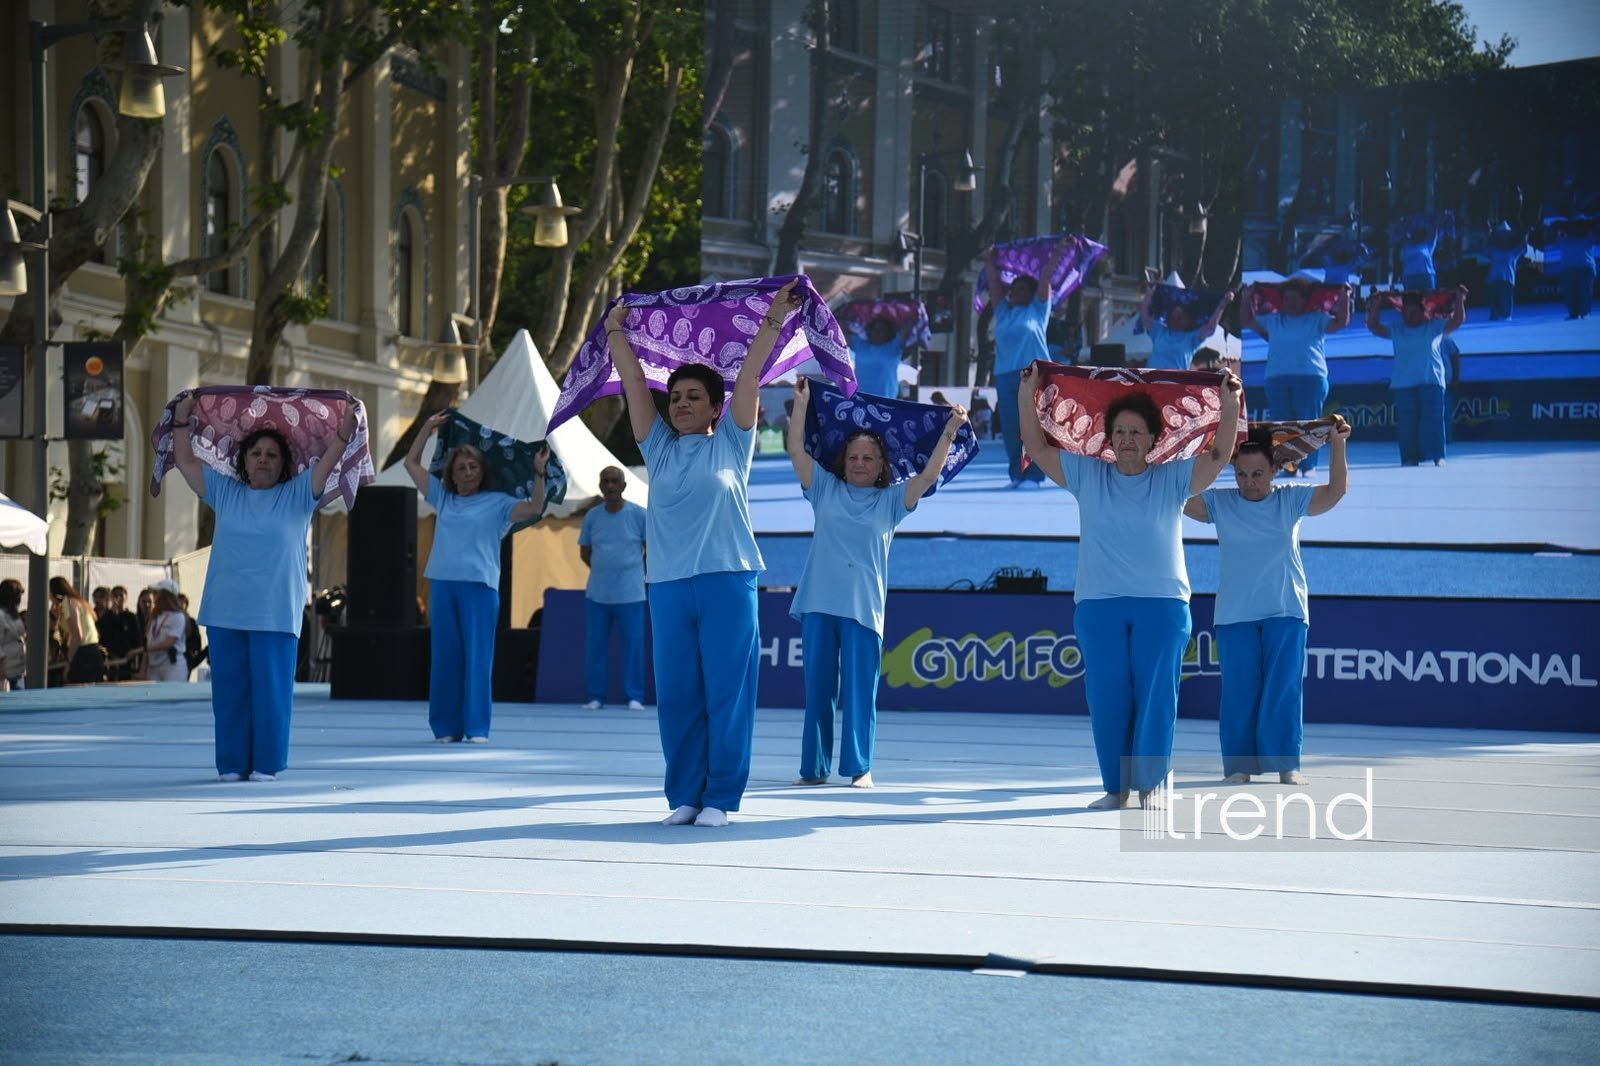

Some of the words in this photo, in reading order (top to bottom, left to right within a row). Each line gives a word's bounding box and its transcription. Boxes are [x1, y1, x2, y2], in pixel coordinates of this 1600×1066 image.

[1453, 397, 1511, 423] ALL
[1531, 402, 1600, 419] INTER
[759, 637, 803, 667] HE
[912, 638, 1016, 682] GYM
[1024, 635, 1085, 680] FO
[1303, 648, 1598, 687] TERNATIONAL
